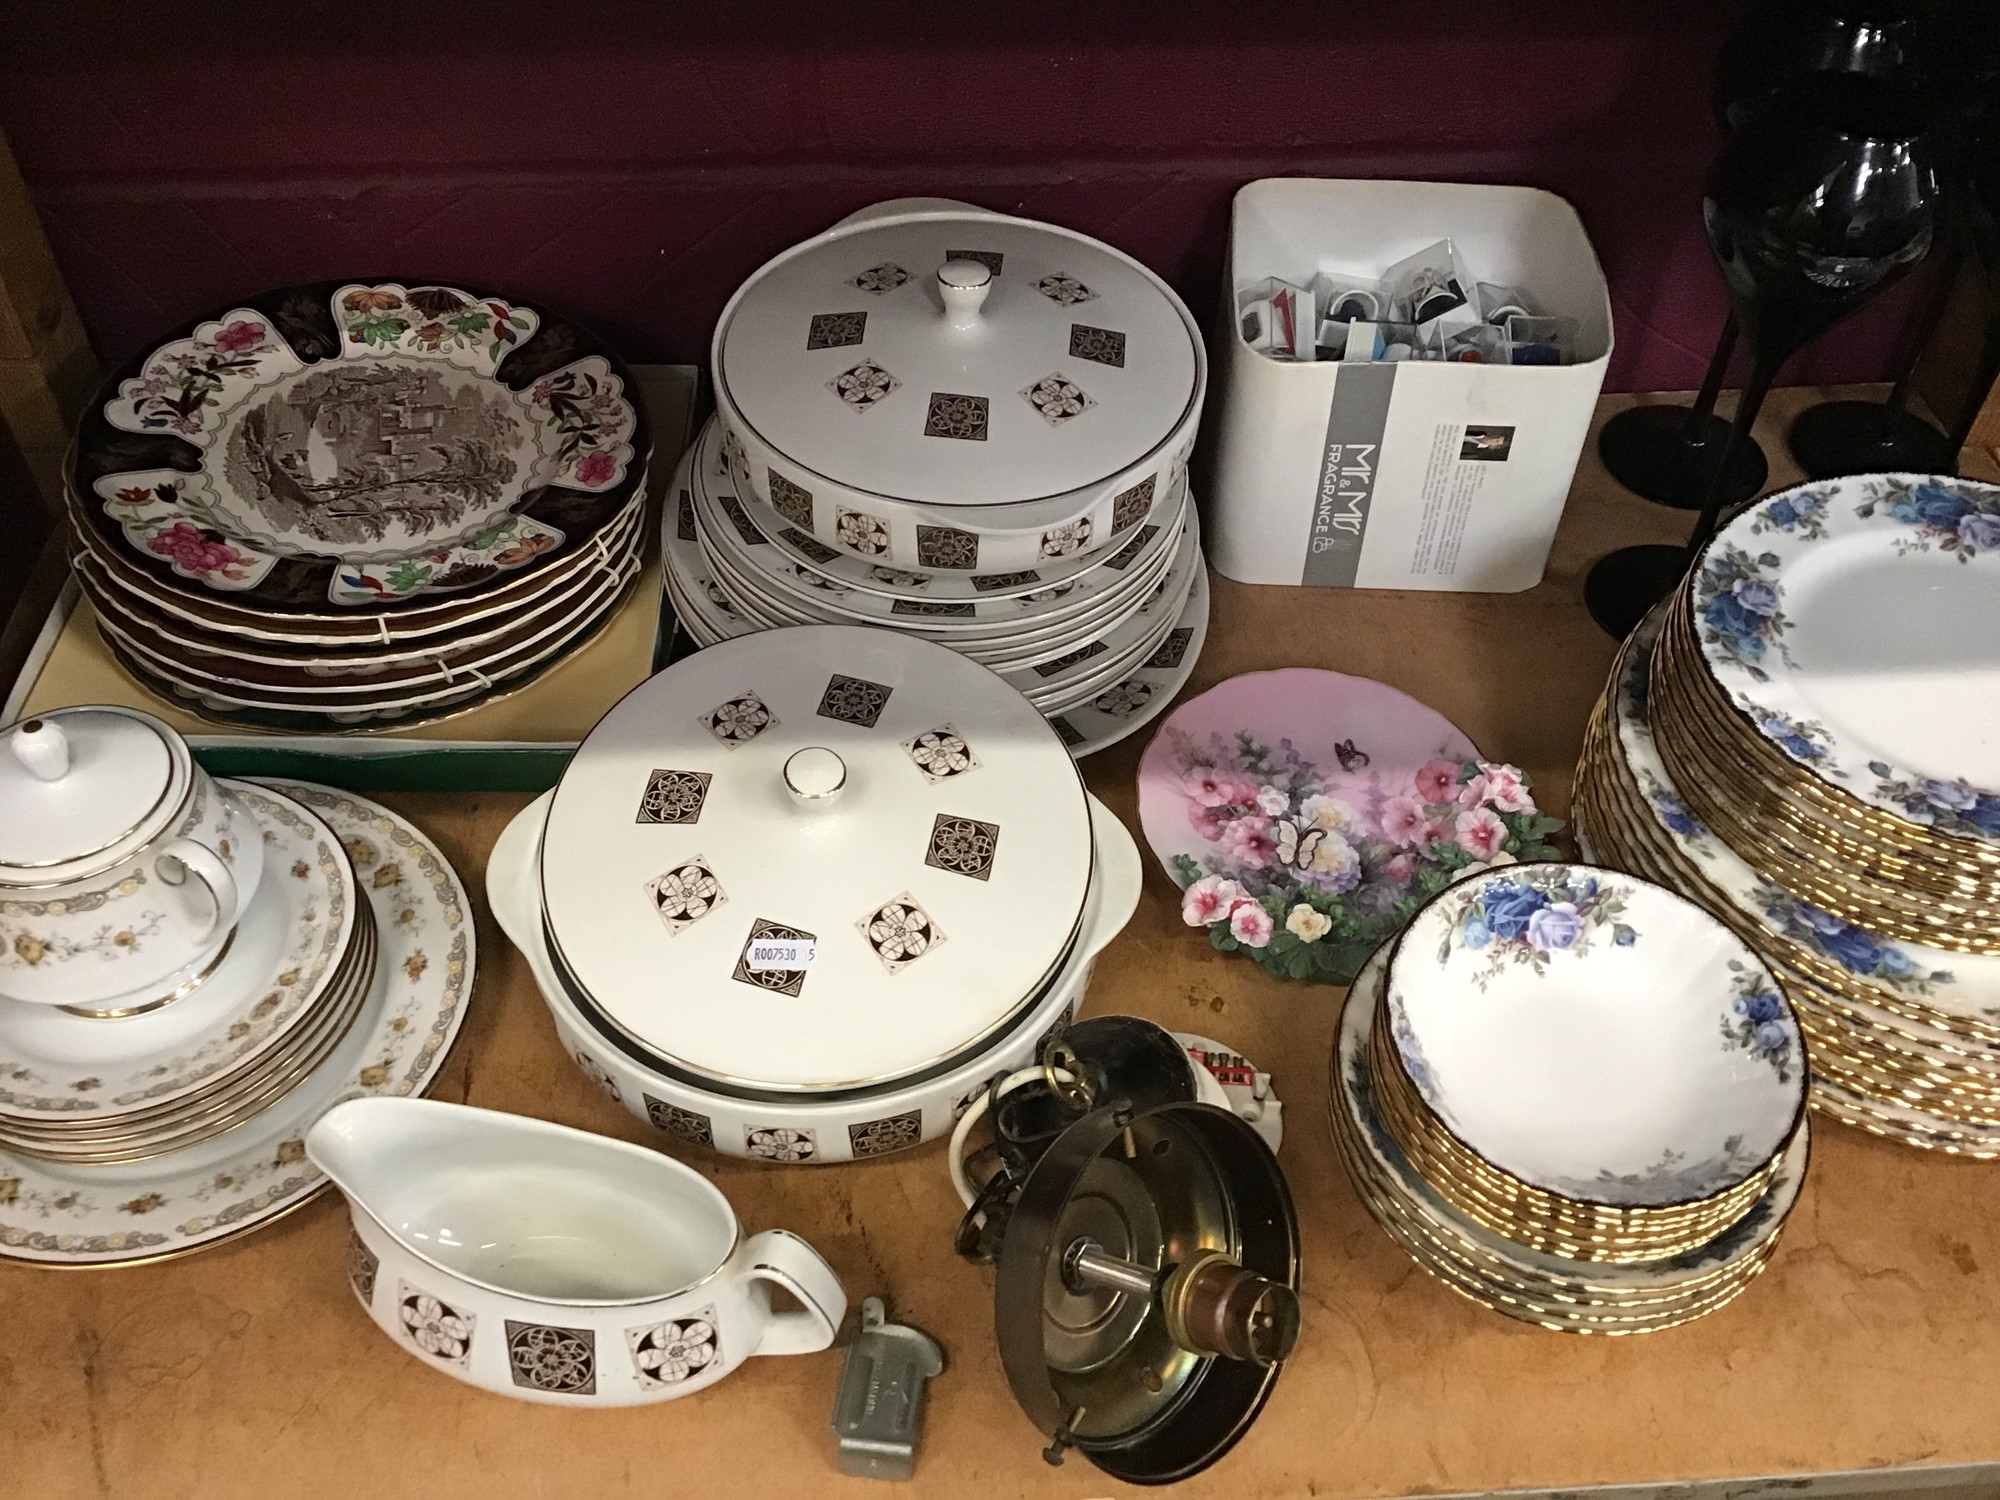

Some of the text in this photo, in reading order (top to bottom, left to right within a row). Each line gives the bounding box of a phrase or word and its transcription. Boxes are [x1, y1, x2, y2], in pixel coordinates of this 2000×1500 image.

[1315, 443, 1343, 534] FRAGRANCE
[754, 947, 815, 961] R007530 5
